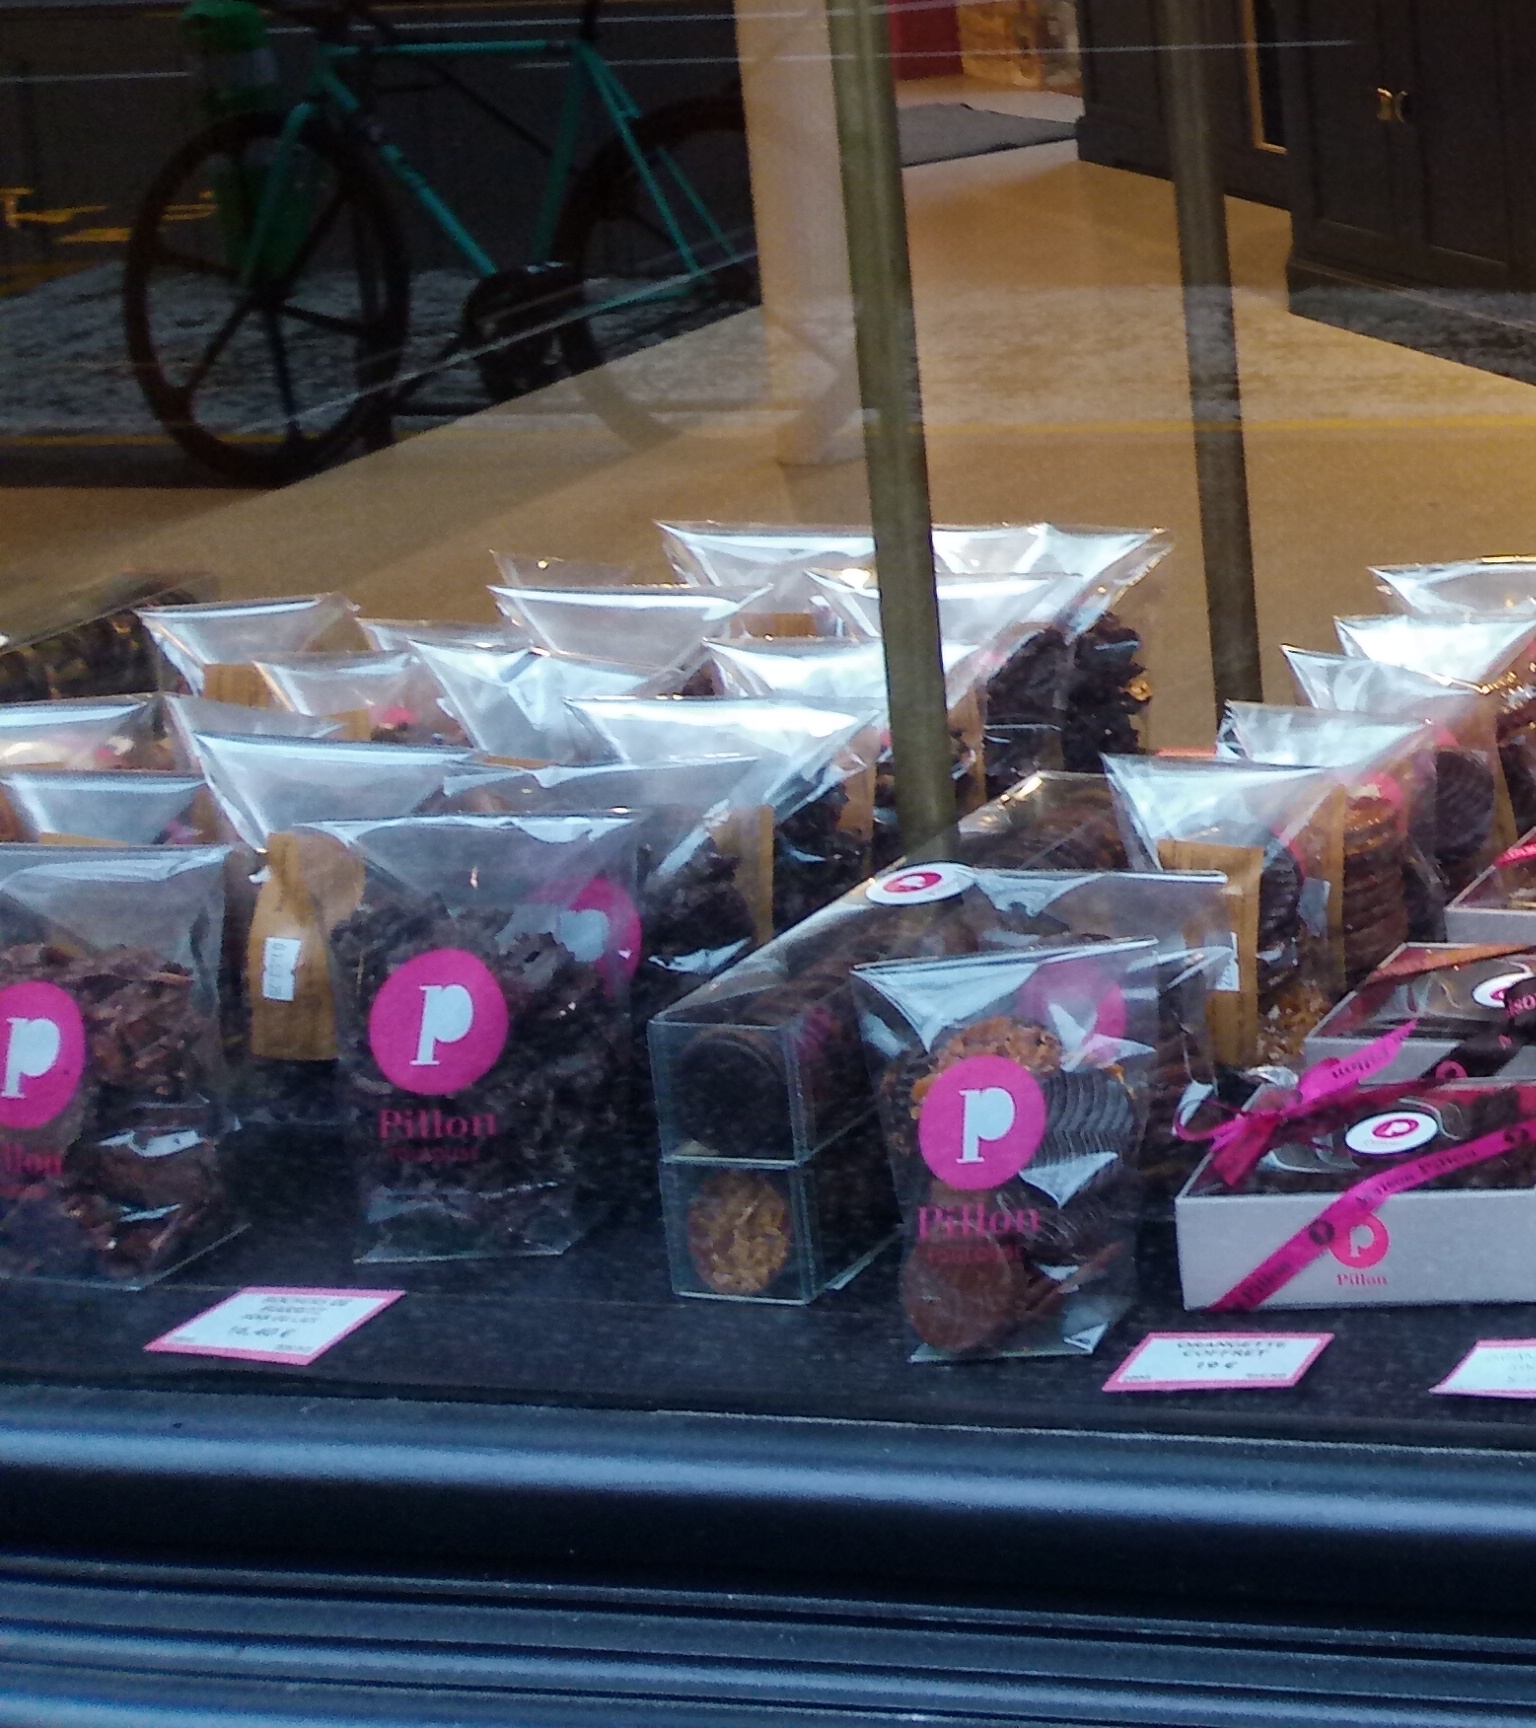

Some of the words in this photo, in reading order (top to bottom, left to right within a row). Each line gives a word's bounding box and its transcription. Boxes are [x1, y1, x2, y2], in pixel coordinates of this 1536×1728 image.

[377, 1108, 498, 1140] Pillon
[918, 1202, 1043, 1240] Pillon
[1336, 1271, 1389, 1288] Pillon
